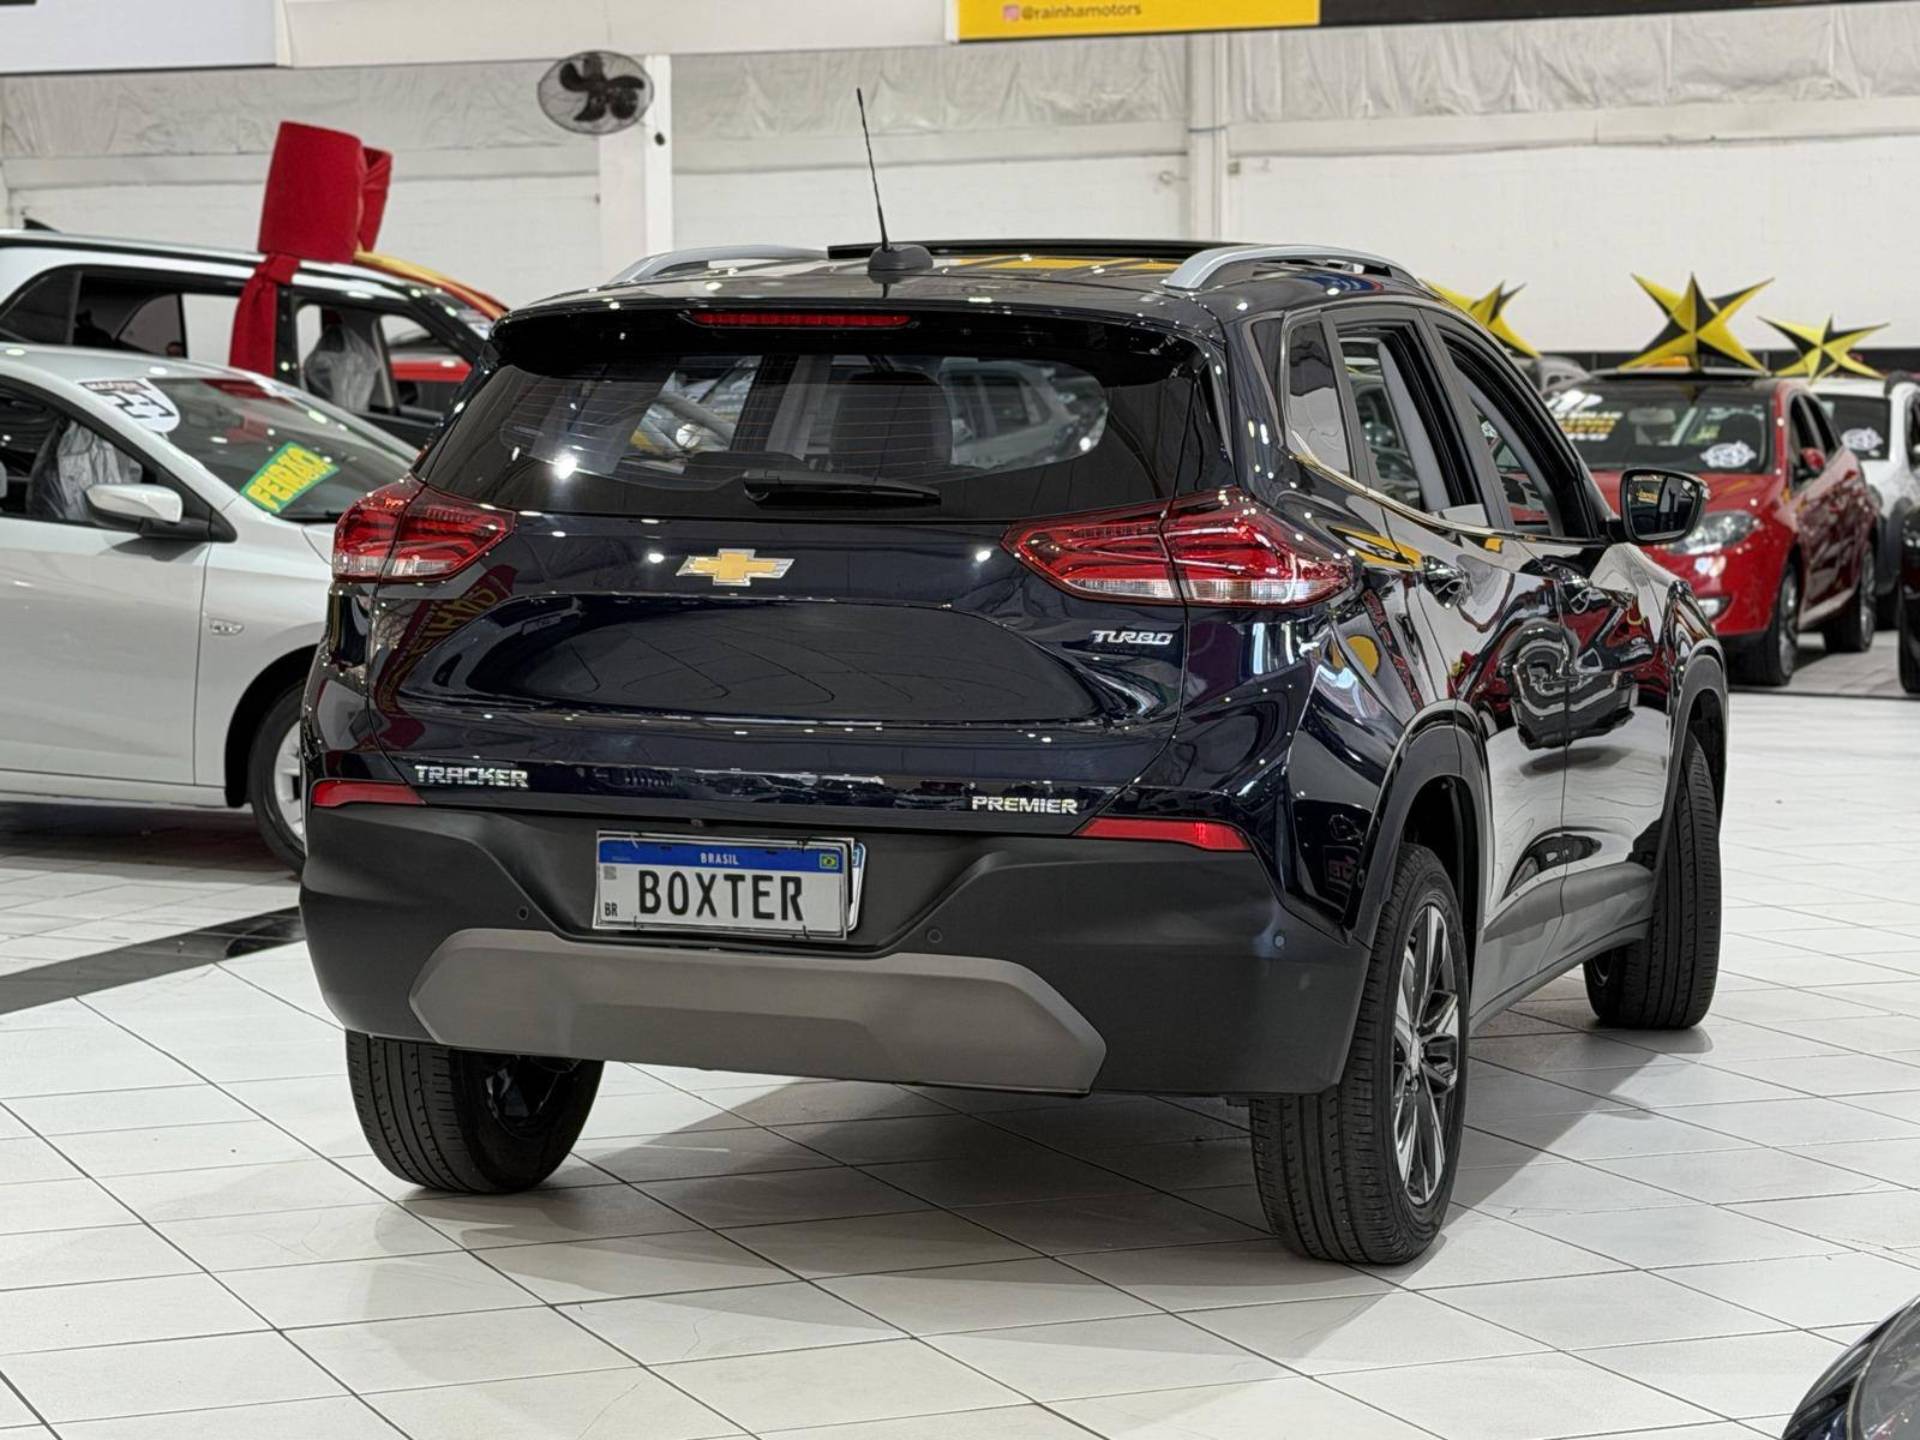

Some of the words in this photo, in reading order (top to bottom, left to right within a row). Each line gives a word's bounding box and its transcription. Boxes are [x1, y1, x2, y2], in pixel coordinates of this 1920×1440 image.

[1021, 4, 1142, 20] @rainhamotors
[1091, 630, 1173, 645] TURBO
[414, 765, 528, 788] TRACKER
[972, 796, 1078, 814] PREMIER
[700, 853, 739, 865] BRASIL
[638, 870, 804, 921] BOXTER
[604, 902, 618, 917] BR
